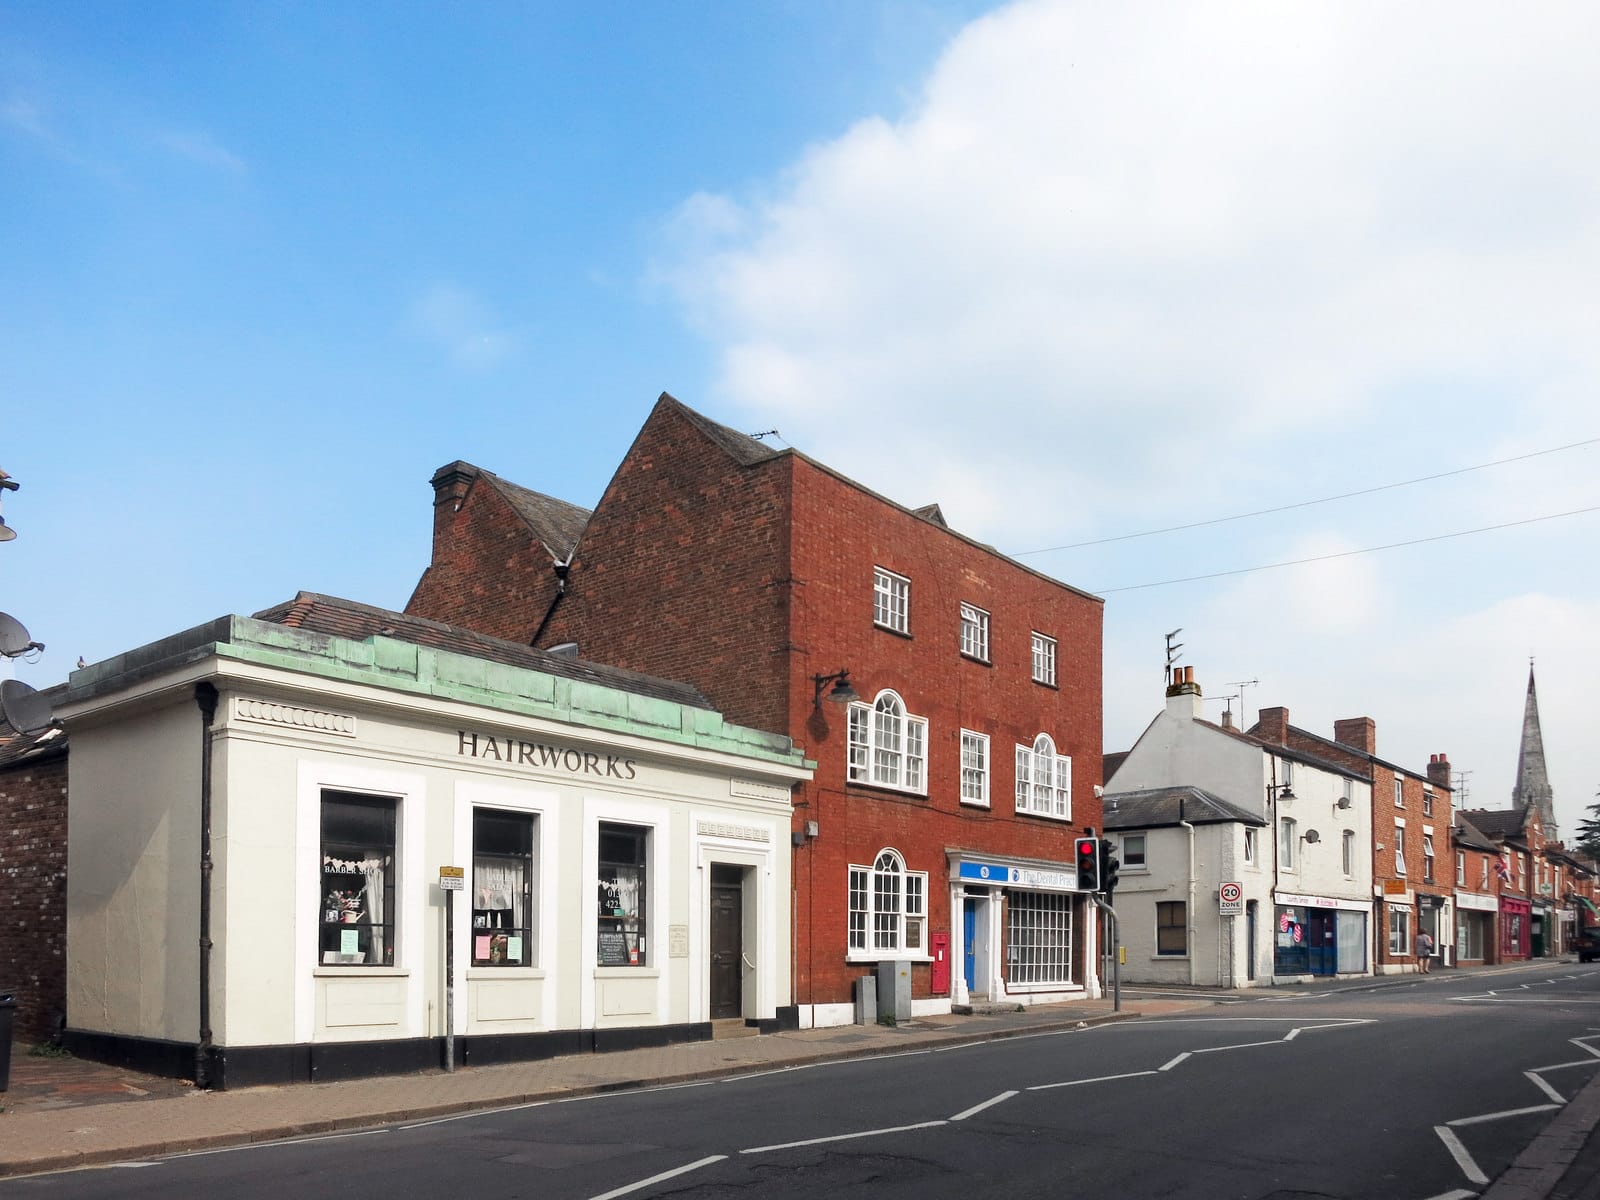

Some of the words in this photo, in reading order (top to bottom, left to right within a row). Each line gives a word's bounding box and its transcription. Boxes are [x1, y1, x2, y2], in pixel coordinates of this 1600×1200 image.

[457, 730, 636, 780] HAIRWORKS
[324, 865, 357, 874] BARBER
[1023, 870, 1036, 883] The
[1037, 872, 1059, 885] Dental
[1060, 873, 1077, 887] Pract
[1224, 888, 1238, 897] 20
